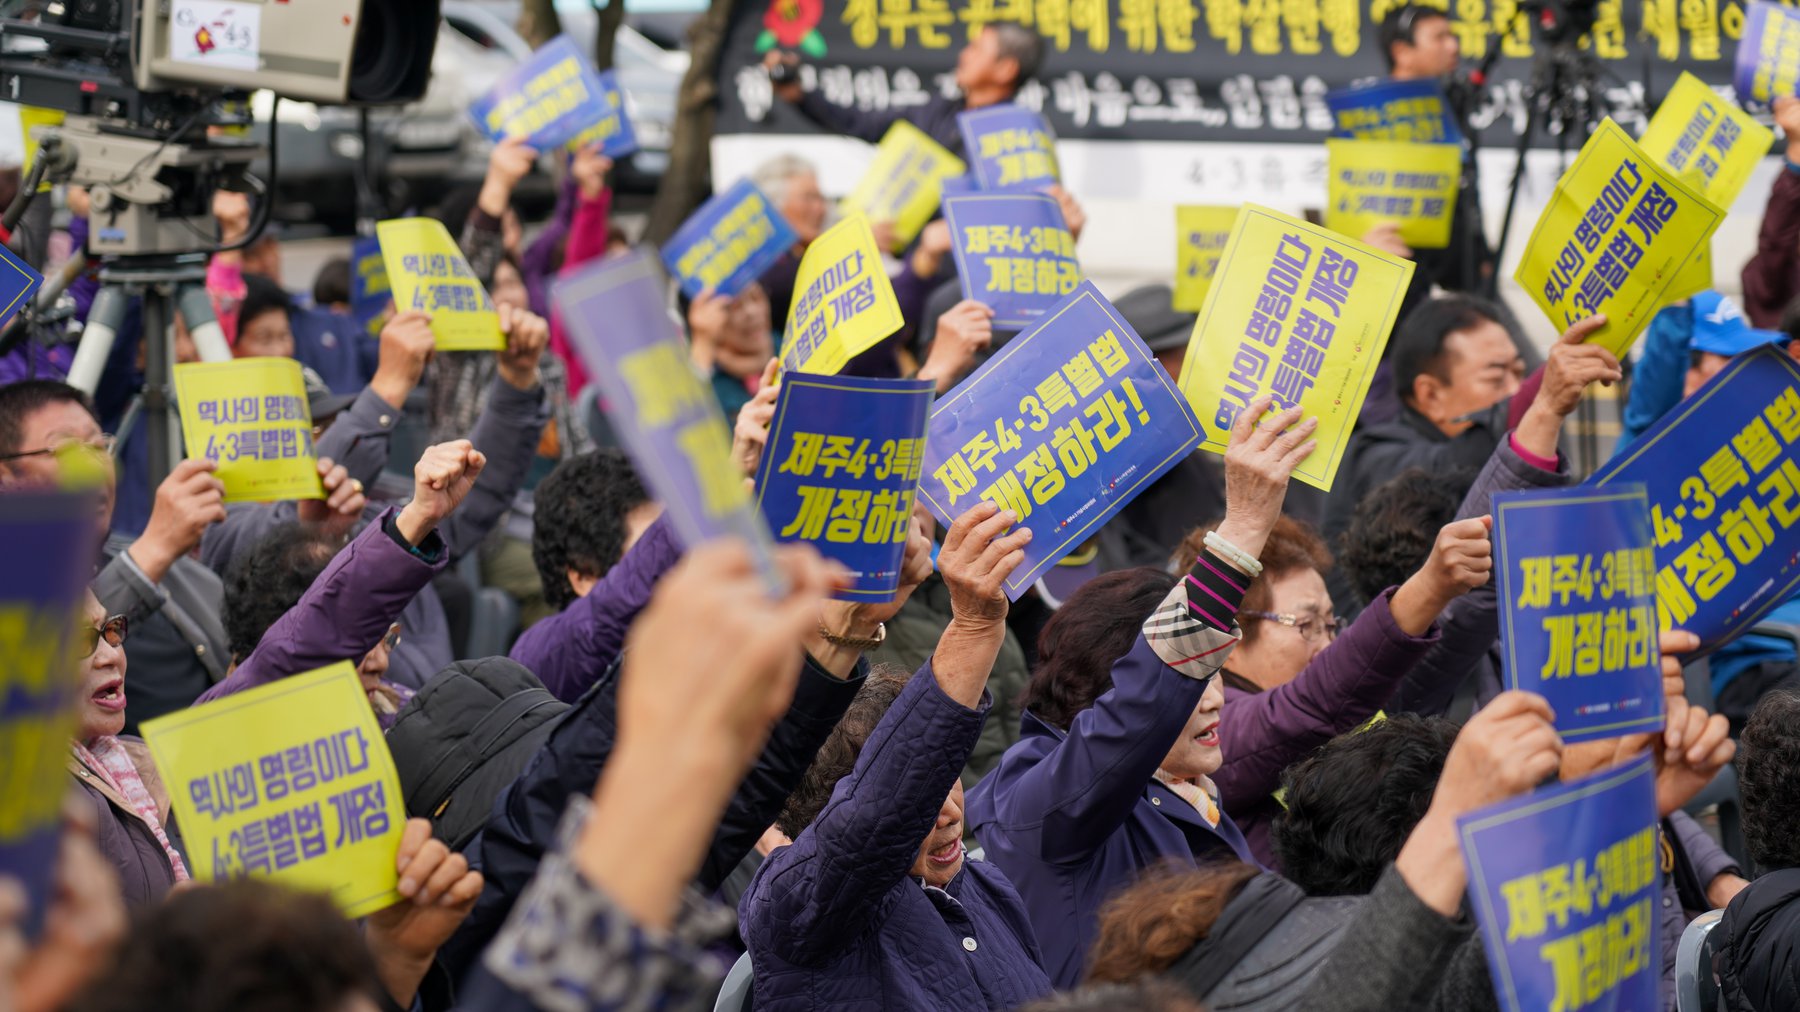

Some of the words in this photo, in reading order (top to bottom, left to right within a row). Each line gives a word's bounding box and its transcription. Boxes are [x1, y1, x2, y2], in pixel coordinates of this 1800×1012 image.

[9, 74, 20, 99] 1
[1543, 239, 1585, 307] 역사의
[1574, 158, 1643, 254] 명령이다
[1625, 180, 1679, 246] 개정
[794, 248, 865, 328] 명령이다
[827, 275, 877, 330] 개정
[1244, 232, 1313, 349] 명령이다
[1255, 307, 1337, 438] 3특별법
[1305, 246, 1359, 319] 개정
[197, 395, 260, 426] 역사의
[205, 428, 298, 462] 4·3특별법
[933, 328, 1131, 506] 제주4·3특별법
[979, 376, 1151, 536] 개정하라!
[1651, 385, 1800, 549] 4·3특별법
[1655, 457, 1800, 633] 개정하라
[1541, 605, 1659, 681] 개정하라!
[188, 761, 259, 821] 역사의
[258, 726, 369, 802] 명령이다
[327, 780, 391, 850] 개정
